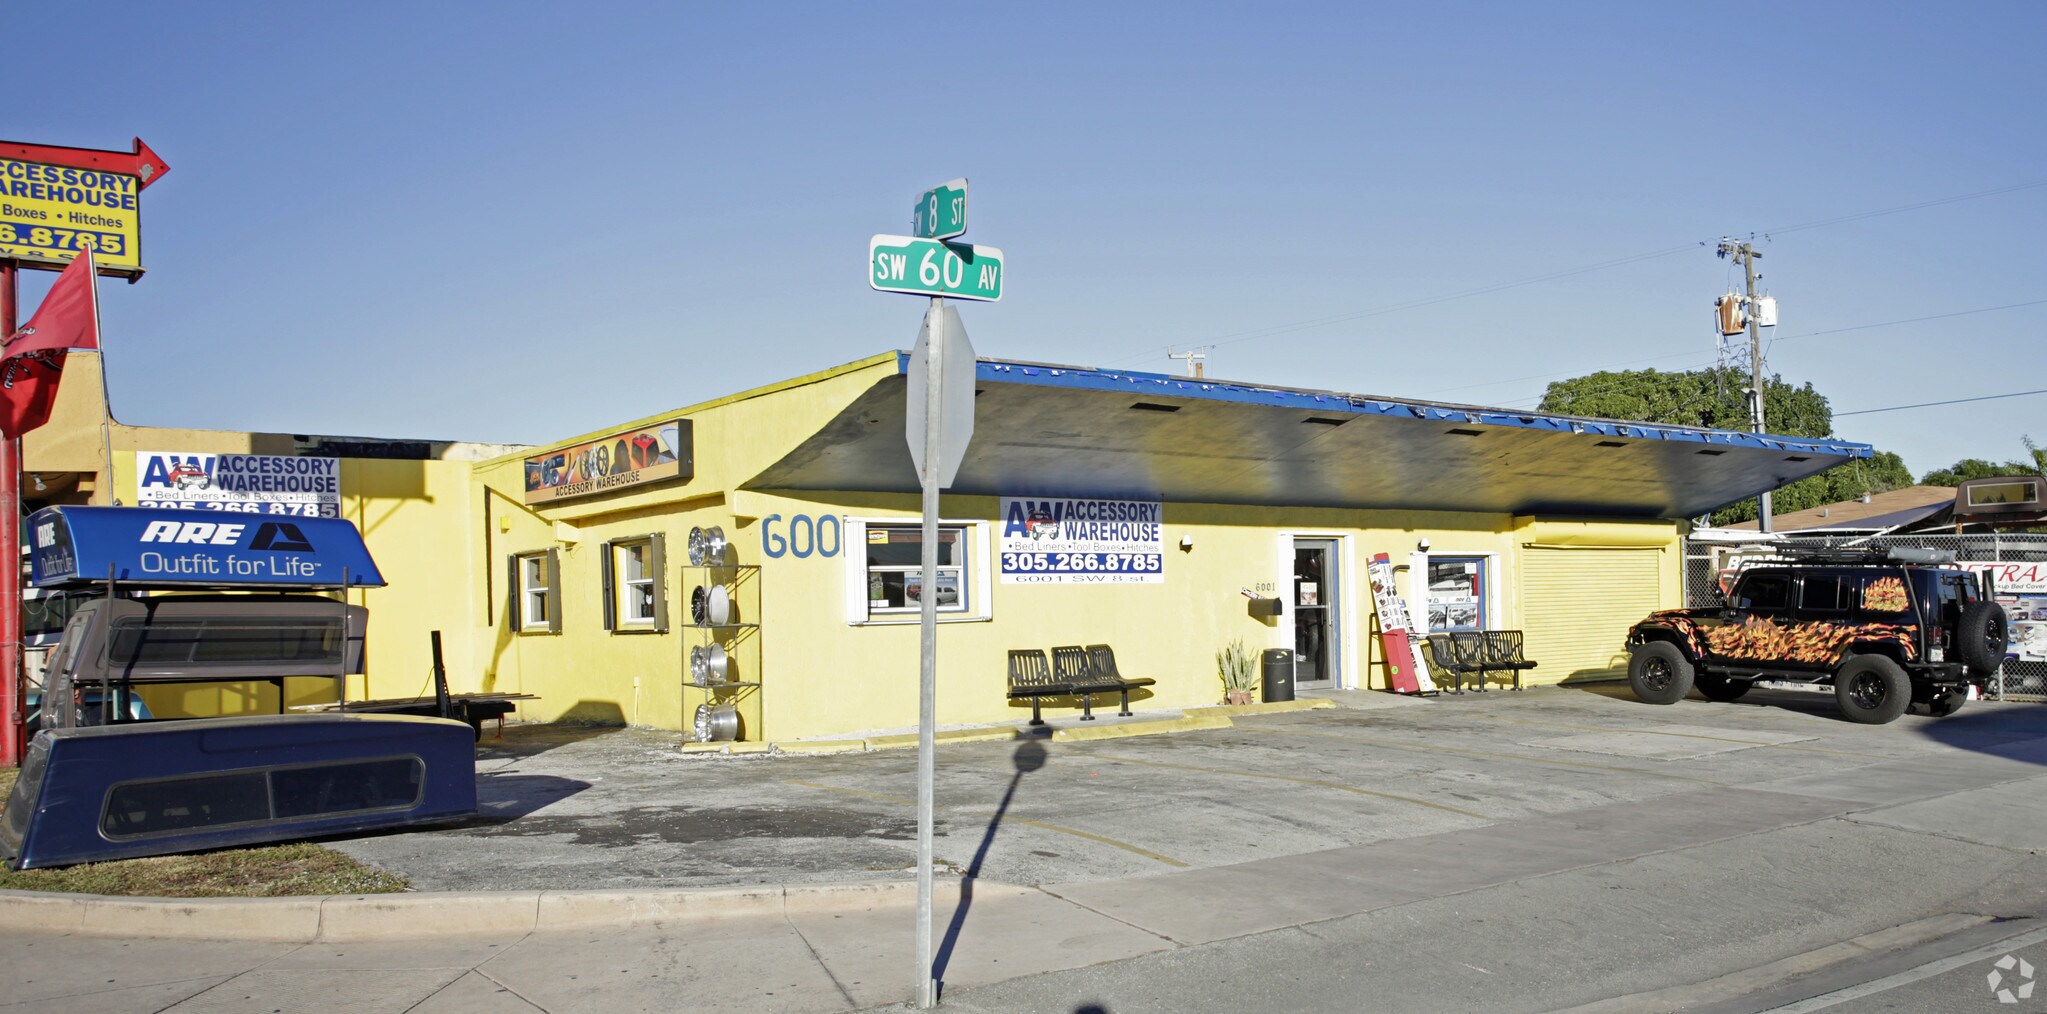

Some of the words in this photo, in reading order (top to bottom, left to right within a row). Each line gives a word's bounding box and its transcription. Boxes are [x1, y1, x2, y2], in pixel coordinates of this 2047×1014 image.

[0, 161, 133, 193] CESSORY
[2, 204, 47, 220] Boxes
[69, 211, 123, 228] Hitches
[929, 194, 938, 233] 8
[952, 197, 963, 225] ST
[877, 252, 906, 281] SW
[919, 247, 964, 289] 60
[978, 264, 998, 291] AV
[142, 455, 216, 488] AW
[217, 455, 335, 476] ACCESSORY
[217, 474, 337, 493] WAREHOUSE
[555, 481, 593, 497] ACCESSORY
[597, 470, 640, 489] WAREHOUSE
[155, 491, 180, 500] Bed
[183, 491, 219, 501] Liners
[226, 492, 250, 501] Tool
[253, 493, 289, 502] Boxes
[295, 493, 336, 502] Hitches
[1004, 501, 1063, 538] AW
[1064, 500, 1158, 522] ACCESSORY
[1064, 521, 1159, 542] WAREHOUSE
[38, 522, 55, 548] ARE
[140, 520, 246, 546] ARE
[1014, 542, 1035, 551] Bed
[1037, 542, 1066, 551] Liners
[1071, 542, 1092, 551] Tool
[1093, 543, 1121, 552] Boxes
[1126, 543, 1159, 552] Hitches
[140, 551, 220, 574] Outfit
[226, 555, 266, 575] for
[1003, 553, 1159, 571] 305.266.8785
[1255, 582, 1275, 592] 6001
